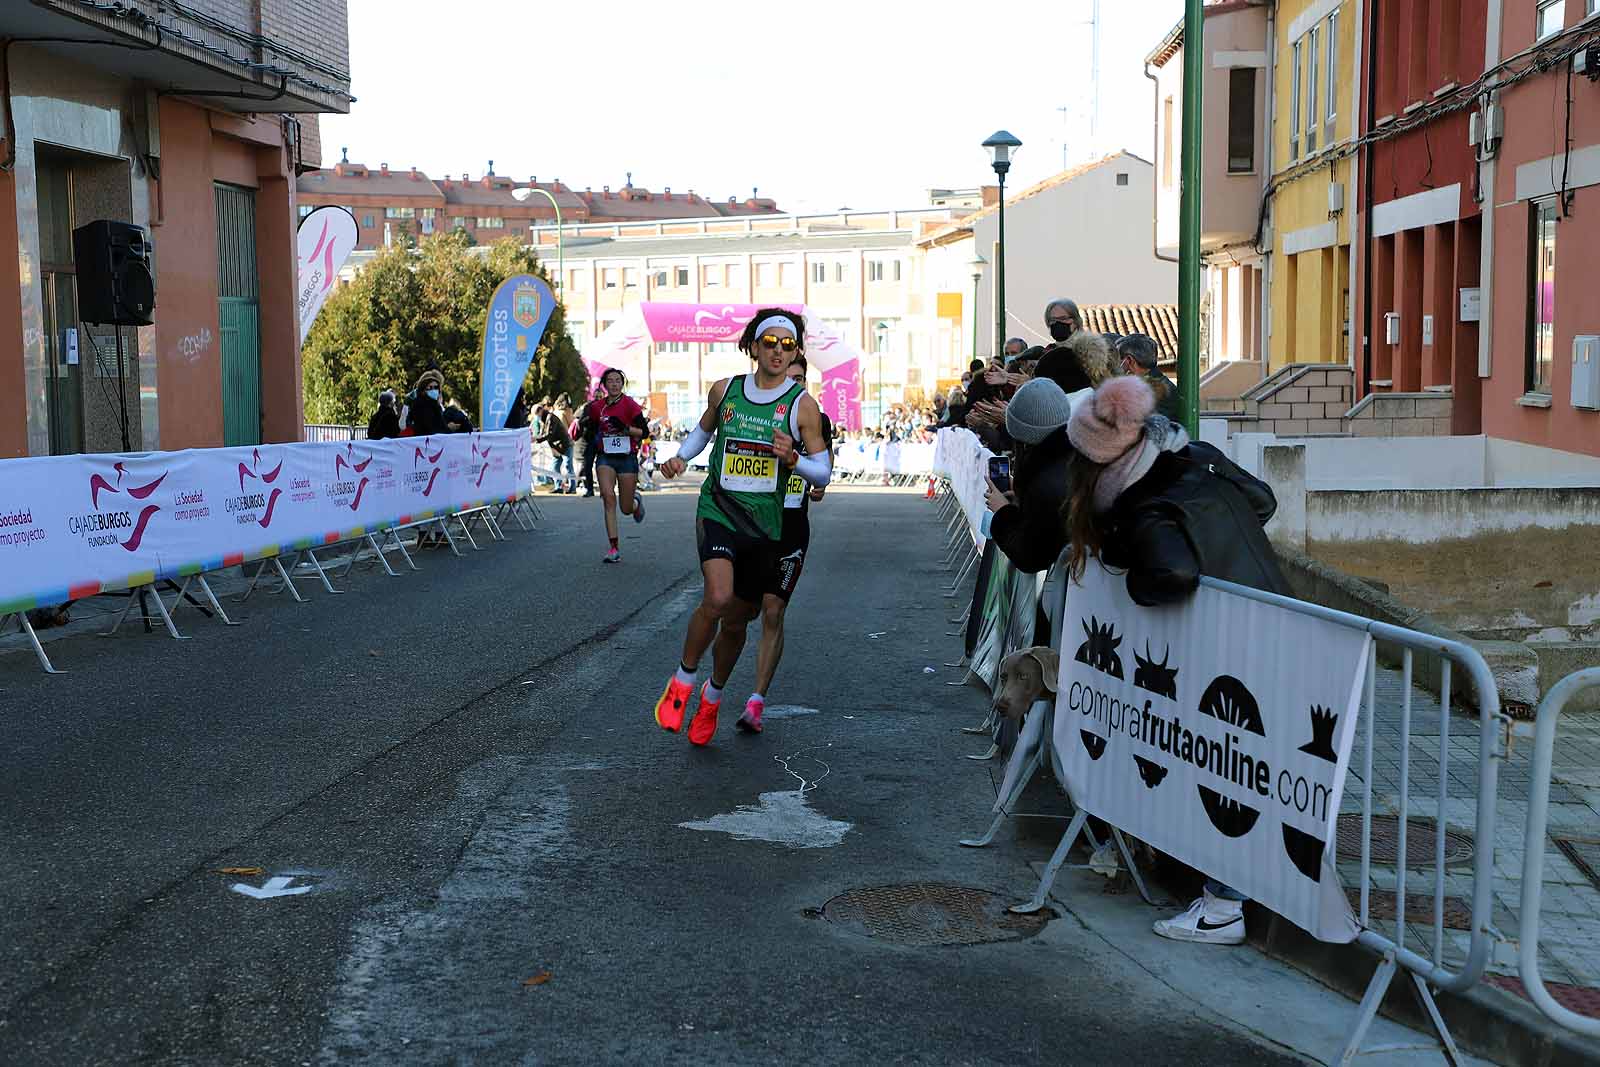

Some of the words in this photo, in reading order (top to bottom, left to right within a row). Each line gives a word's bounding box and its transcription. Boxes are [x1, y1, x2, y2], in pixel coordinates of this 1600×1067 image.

[667, 324, 732, 336] CAJADEBURGOS
[489, 309, 512, 416] Deportes
[736, 412, 771, 427] VILLARREAL
[729, 457, 769, 476] JORGE
[174, 494, 181, 506] La
[181, 489, 203, 504] Sociedad
[224, 493, 266, 515] CAJADEBURGOS
[174, 510, 188, 521] como
[189, 507, 209, 521] proyecto
[68, 511, 132, 538] CAJADEBURGOS
[13, 528, 46, 549] proyecto
[87, 533, 119, 548] FUNDACIÓN
[1069, 681, 1333, 822] comprafrutaonline.com
